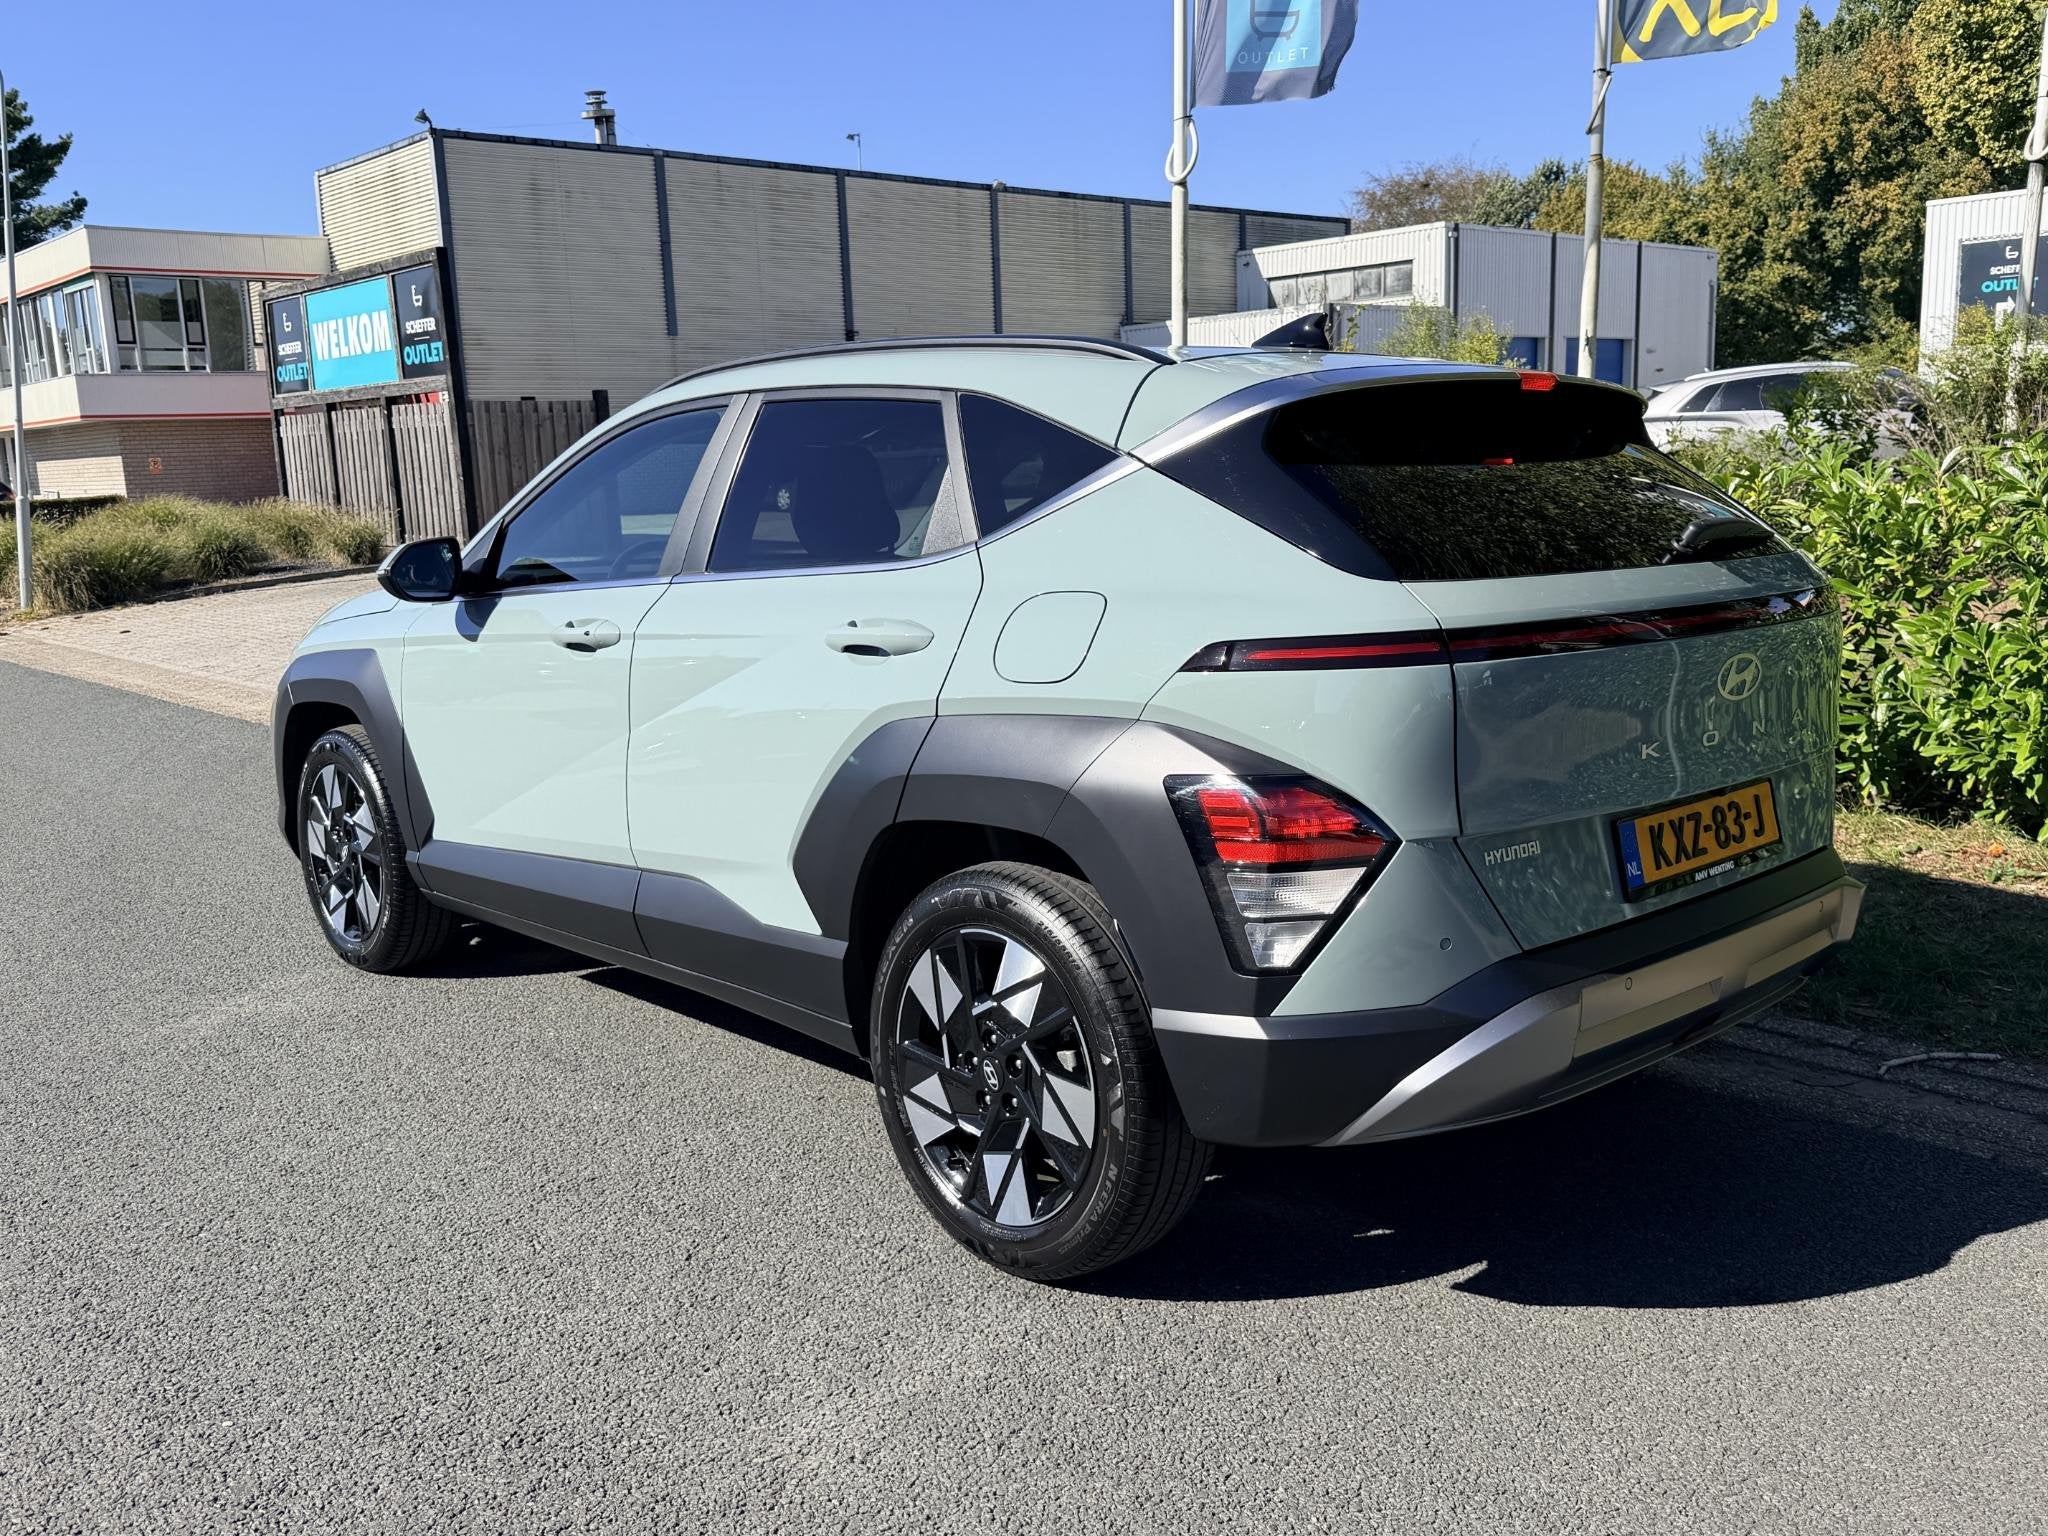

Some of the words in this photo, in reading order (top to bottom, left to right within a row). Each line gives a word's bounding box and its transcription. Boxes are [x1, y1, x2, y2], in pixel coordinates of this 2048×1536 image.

[1238, 47, 1308, 64] OUTLET
[1989, 264, 2021, 275] SCHEFF
[405, 316, 436, 334] SCHEFFER
[312, 310, 392, 361] WELKOM
[278, 341, 302, 355] SCHEFFER
[403, 341, 444, 365] OUTLET
[276, 362, 308, 382] OUTLET
[1641, 708, 1803, 760] KONA
[1649, 794, 1765, 871] KXZ-83-J
[1484, 840, 1541, 866] HYUNDAI
[1627, 862, 1641, 877] NL
[1695, 869, 1708, 881] AMV
[1709, 860, 1735, 876] WENTING
